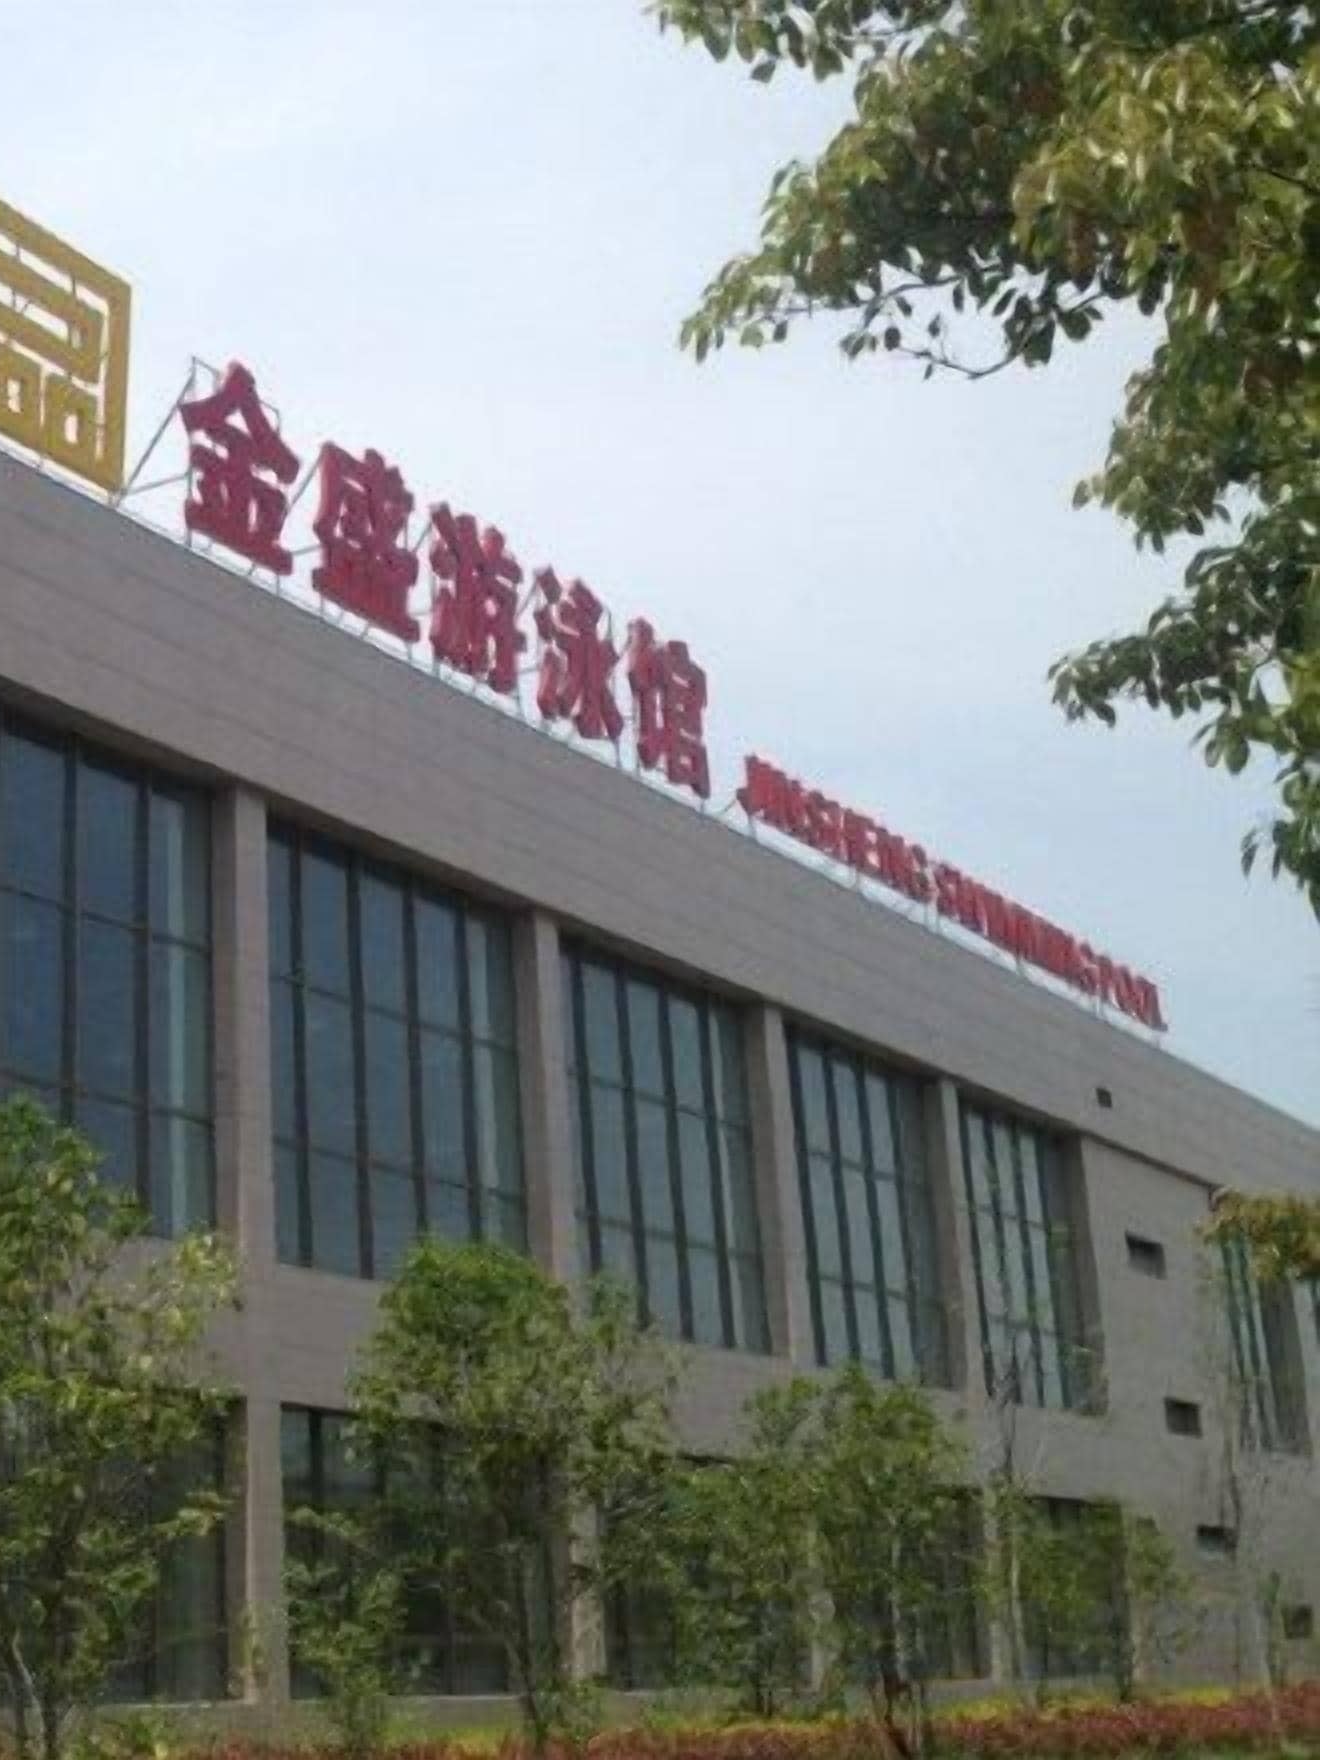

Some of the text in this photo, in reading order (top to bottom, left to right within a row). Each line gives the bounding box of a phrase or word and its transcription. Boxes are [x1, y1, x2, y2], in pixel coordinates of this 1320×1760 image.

[179, 360, 712, 799] 金盛游泳馆
